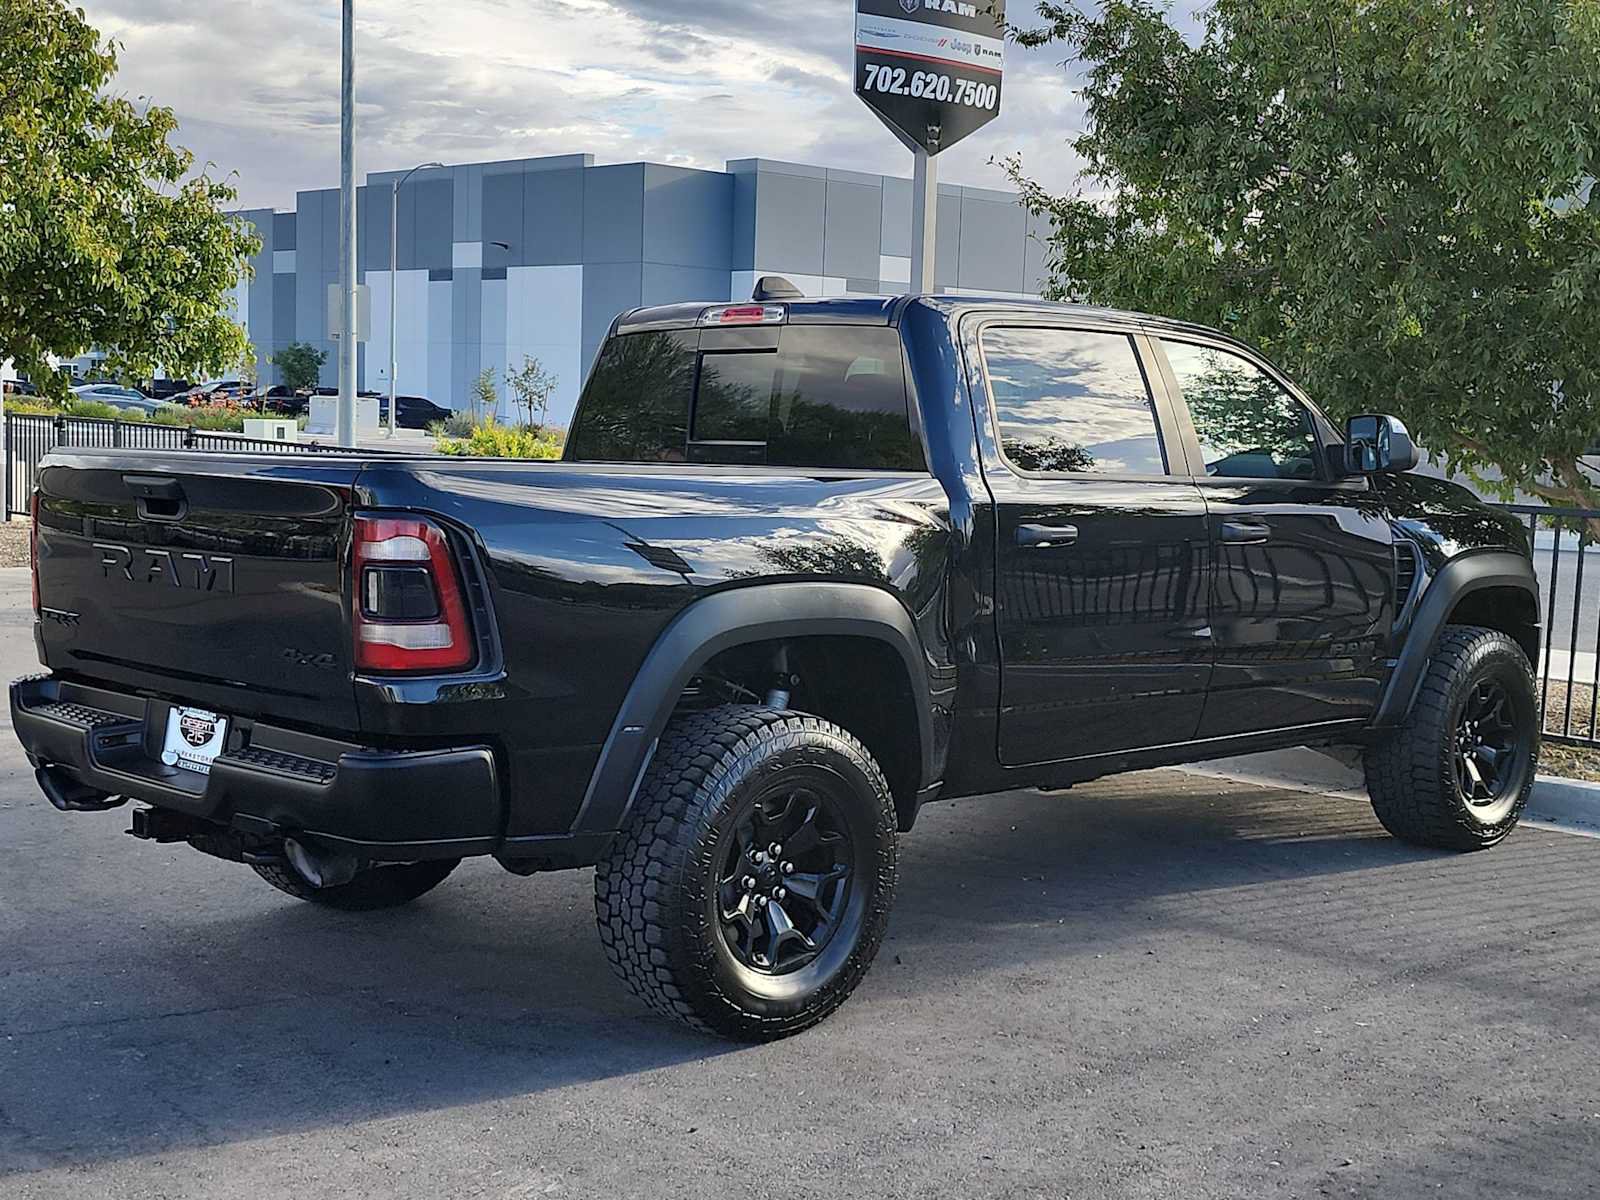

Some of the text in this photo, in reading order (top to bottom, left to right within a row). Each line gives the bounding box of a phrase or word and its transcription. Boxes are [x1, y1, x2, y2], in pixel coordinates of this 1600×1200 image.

[924, 0, 976, 18] RAM
[864, 64, 997, 110] 702.620.7500
[92, 542, 235, 593] RAM
[182, 717, 212, 732] DESERT
[186, 730, 205, 744] 215
